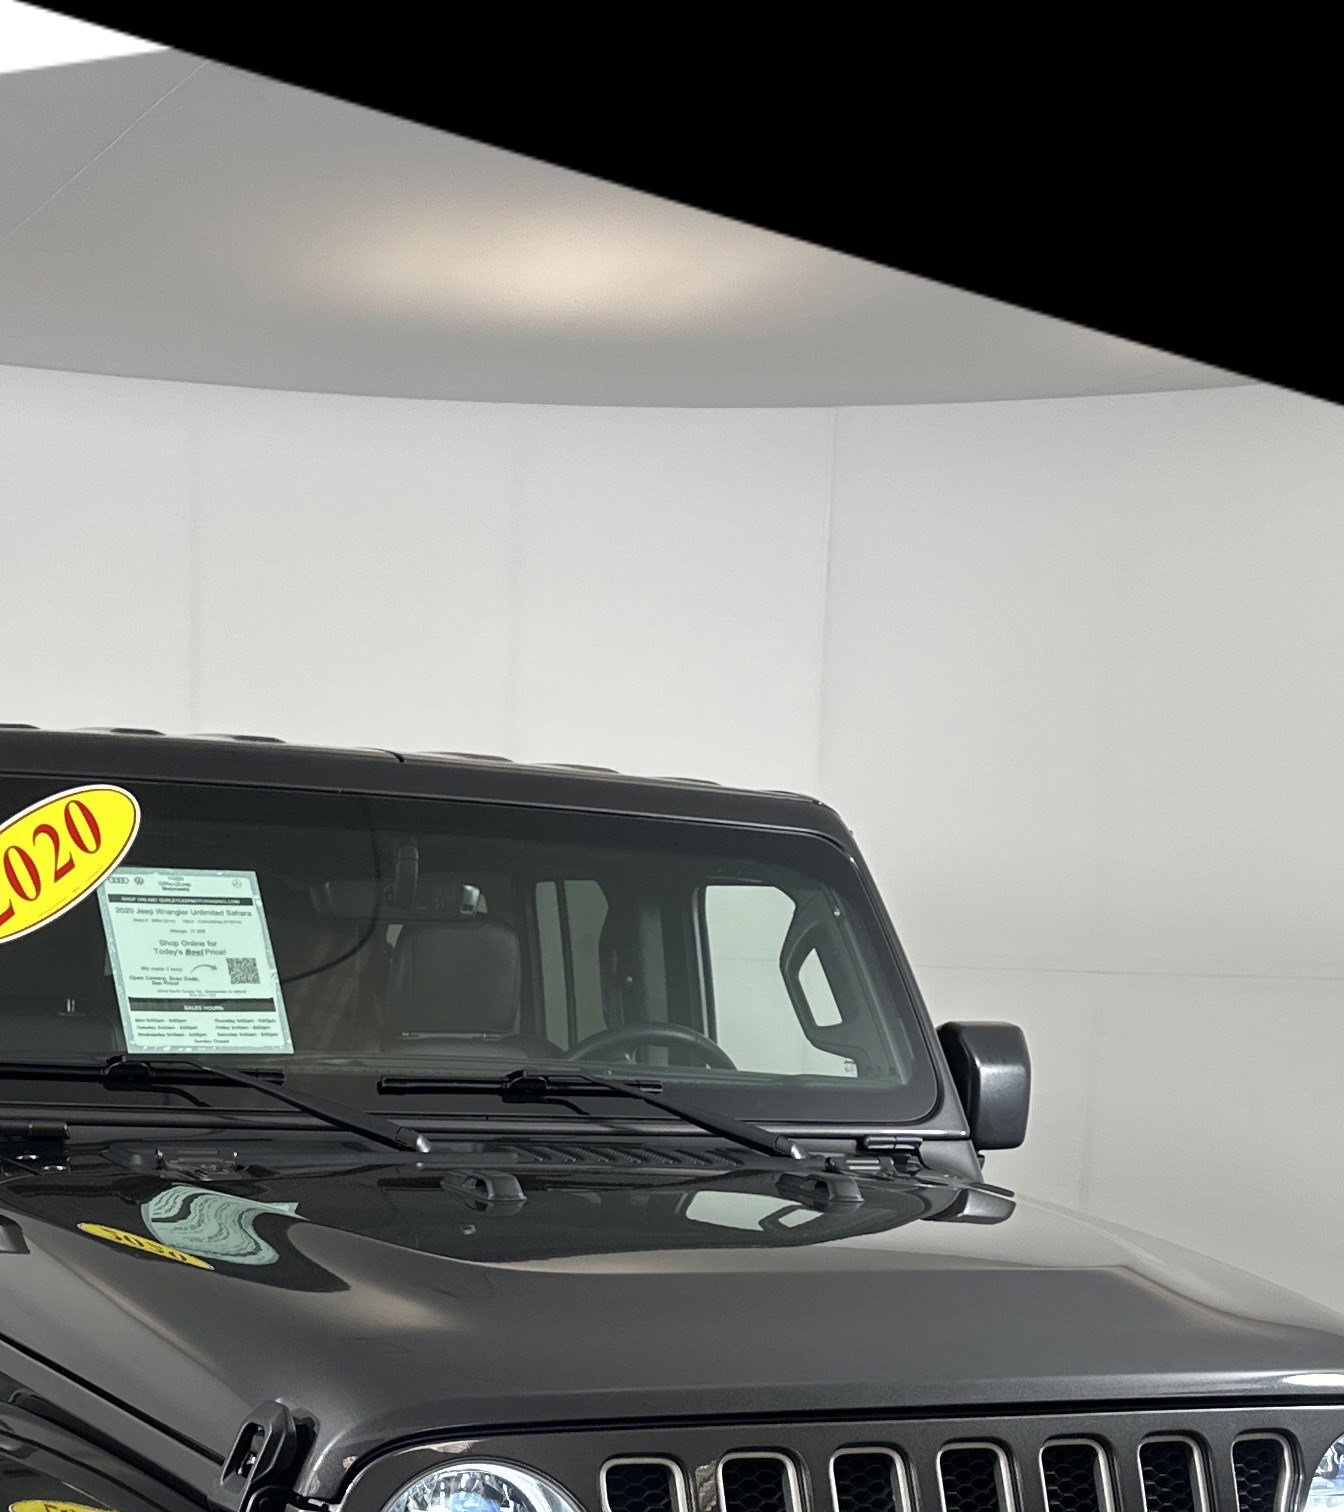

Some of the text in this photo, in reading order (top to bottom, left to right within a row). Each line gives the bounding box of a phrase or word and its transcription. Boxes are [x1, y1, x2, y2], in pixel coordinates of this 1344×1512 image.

[137, 908, 154, 916] Jeep
[156, 908, 188, 917] Wrangler
[226, 909, 252, 917] Sahara
[159, 939, 179, 948] Shop
[153, 947, 183, 956] Today's
